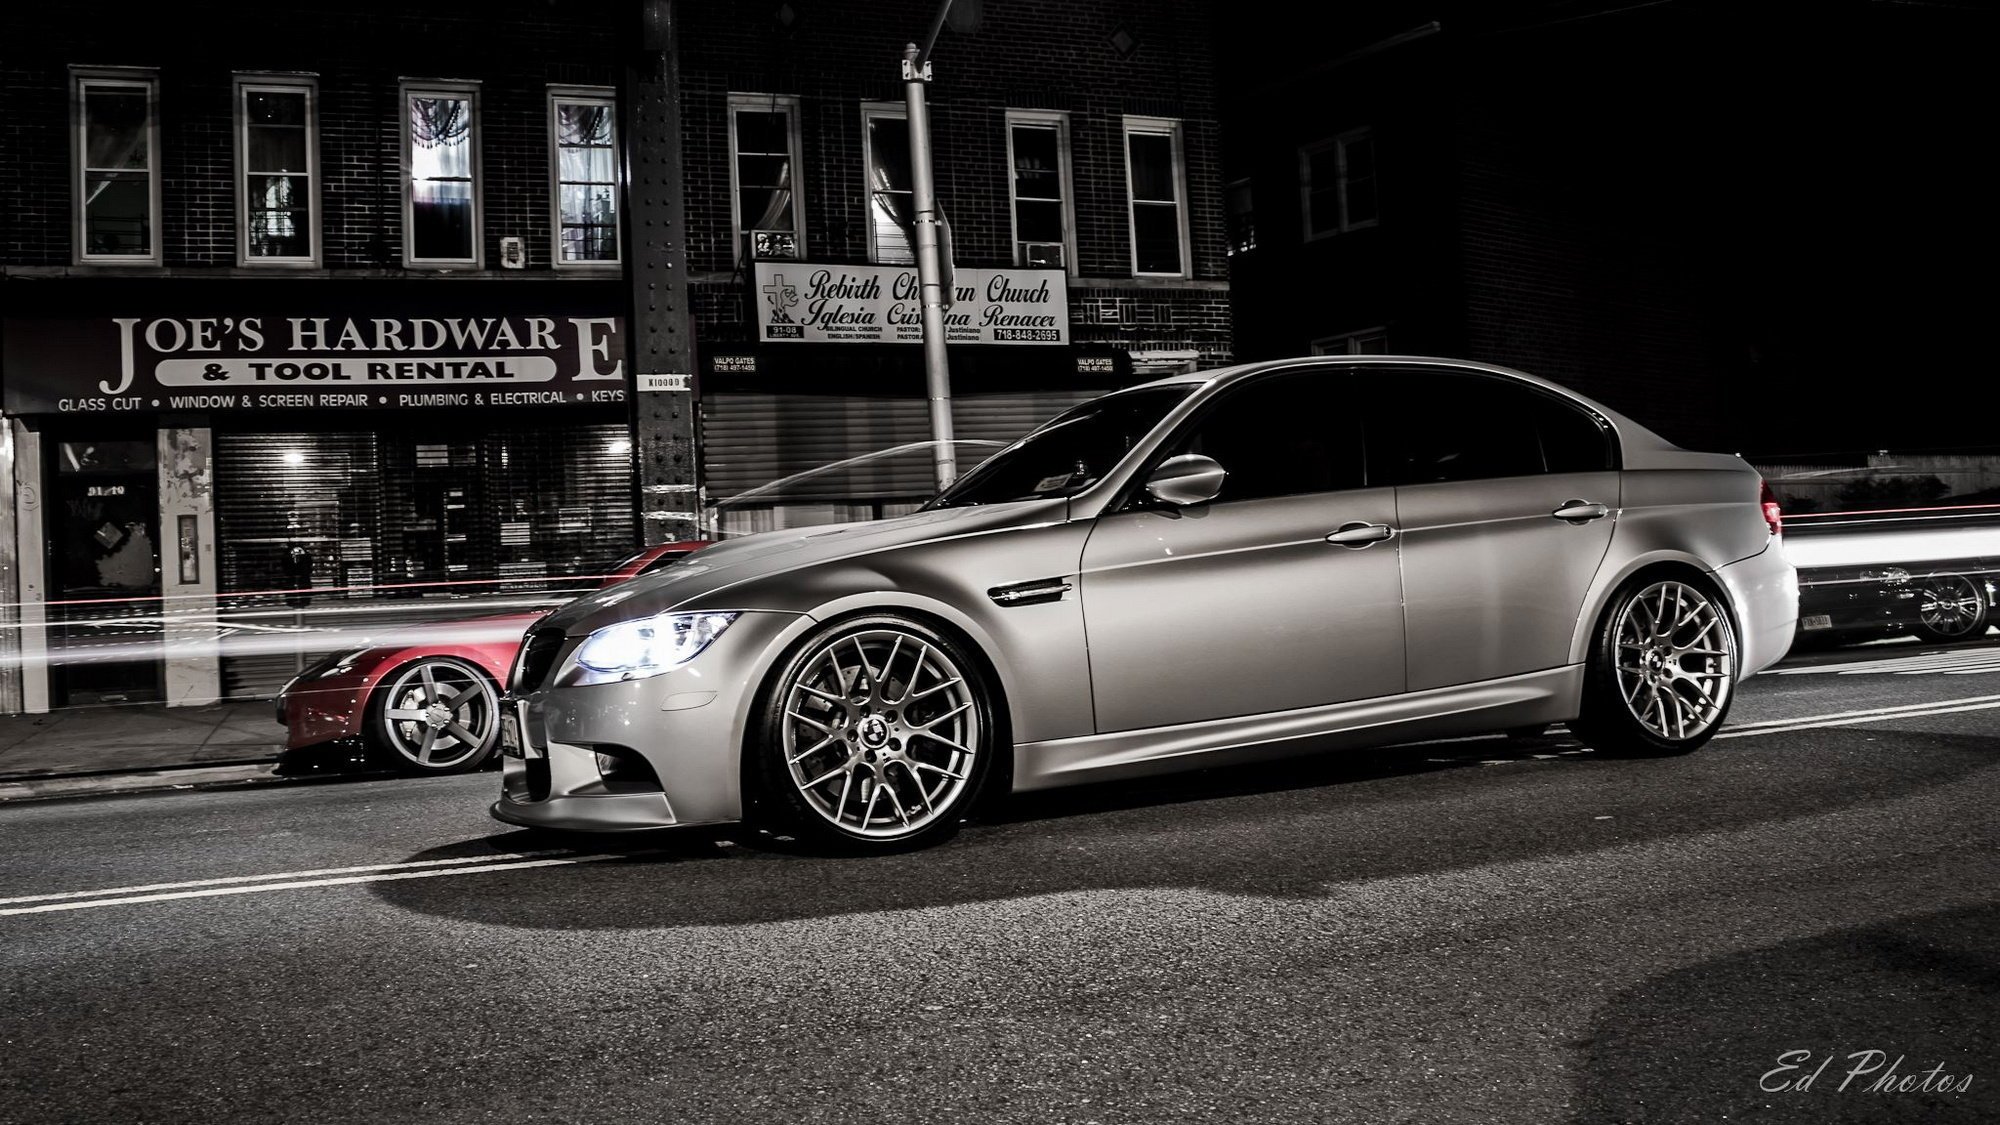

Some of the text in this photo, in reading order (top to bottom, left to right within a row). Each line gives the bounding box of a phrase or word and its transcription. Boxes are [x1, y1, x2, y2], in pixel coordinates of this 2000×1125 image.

[804, 269, 882, 300] Rebirth
[987, 274, 1051, 303] Church
[801, 298, 1056, 330] Iglesia Crisna Renacer
[996, 328, 1058, 341] 718-848-2695
[99, 317, 623, 395] JOE'S HARDWARE
[202, 361, 514, 381] & TOOL RENTAL
[58, 389, 625, 412] GLASS CUT WINDOW & SCREEN REPAIR PLUMBING & ELECTRICAL KEYS
